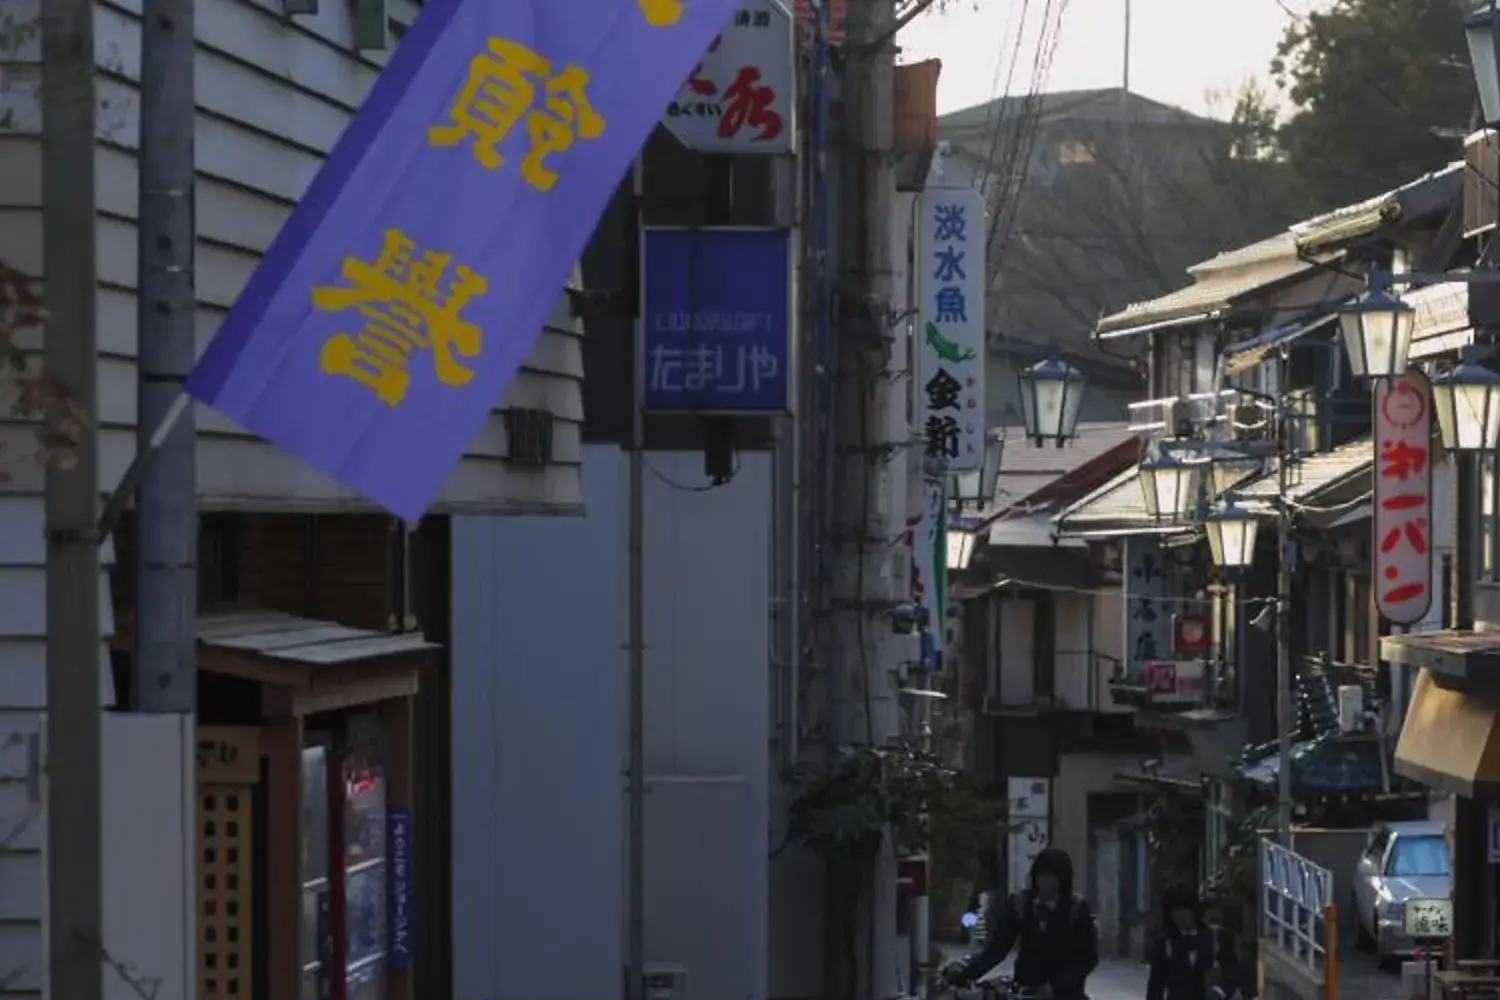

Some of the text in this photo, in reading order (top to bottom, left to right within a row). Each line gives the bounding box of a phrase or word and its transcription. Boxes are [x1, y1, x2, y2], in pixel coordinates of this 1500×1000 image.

[933, 205, 967, 324] 淡水魚
[647, 343, 779, 395] たまりや
